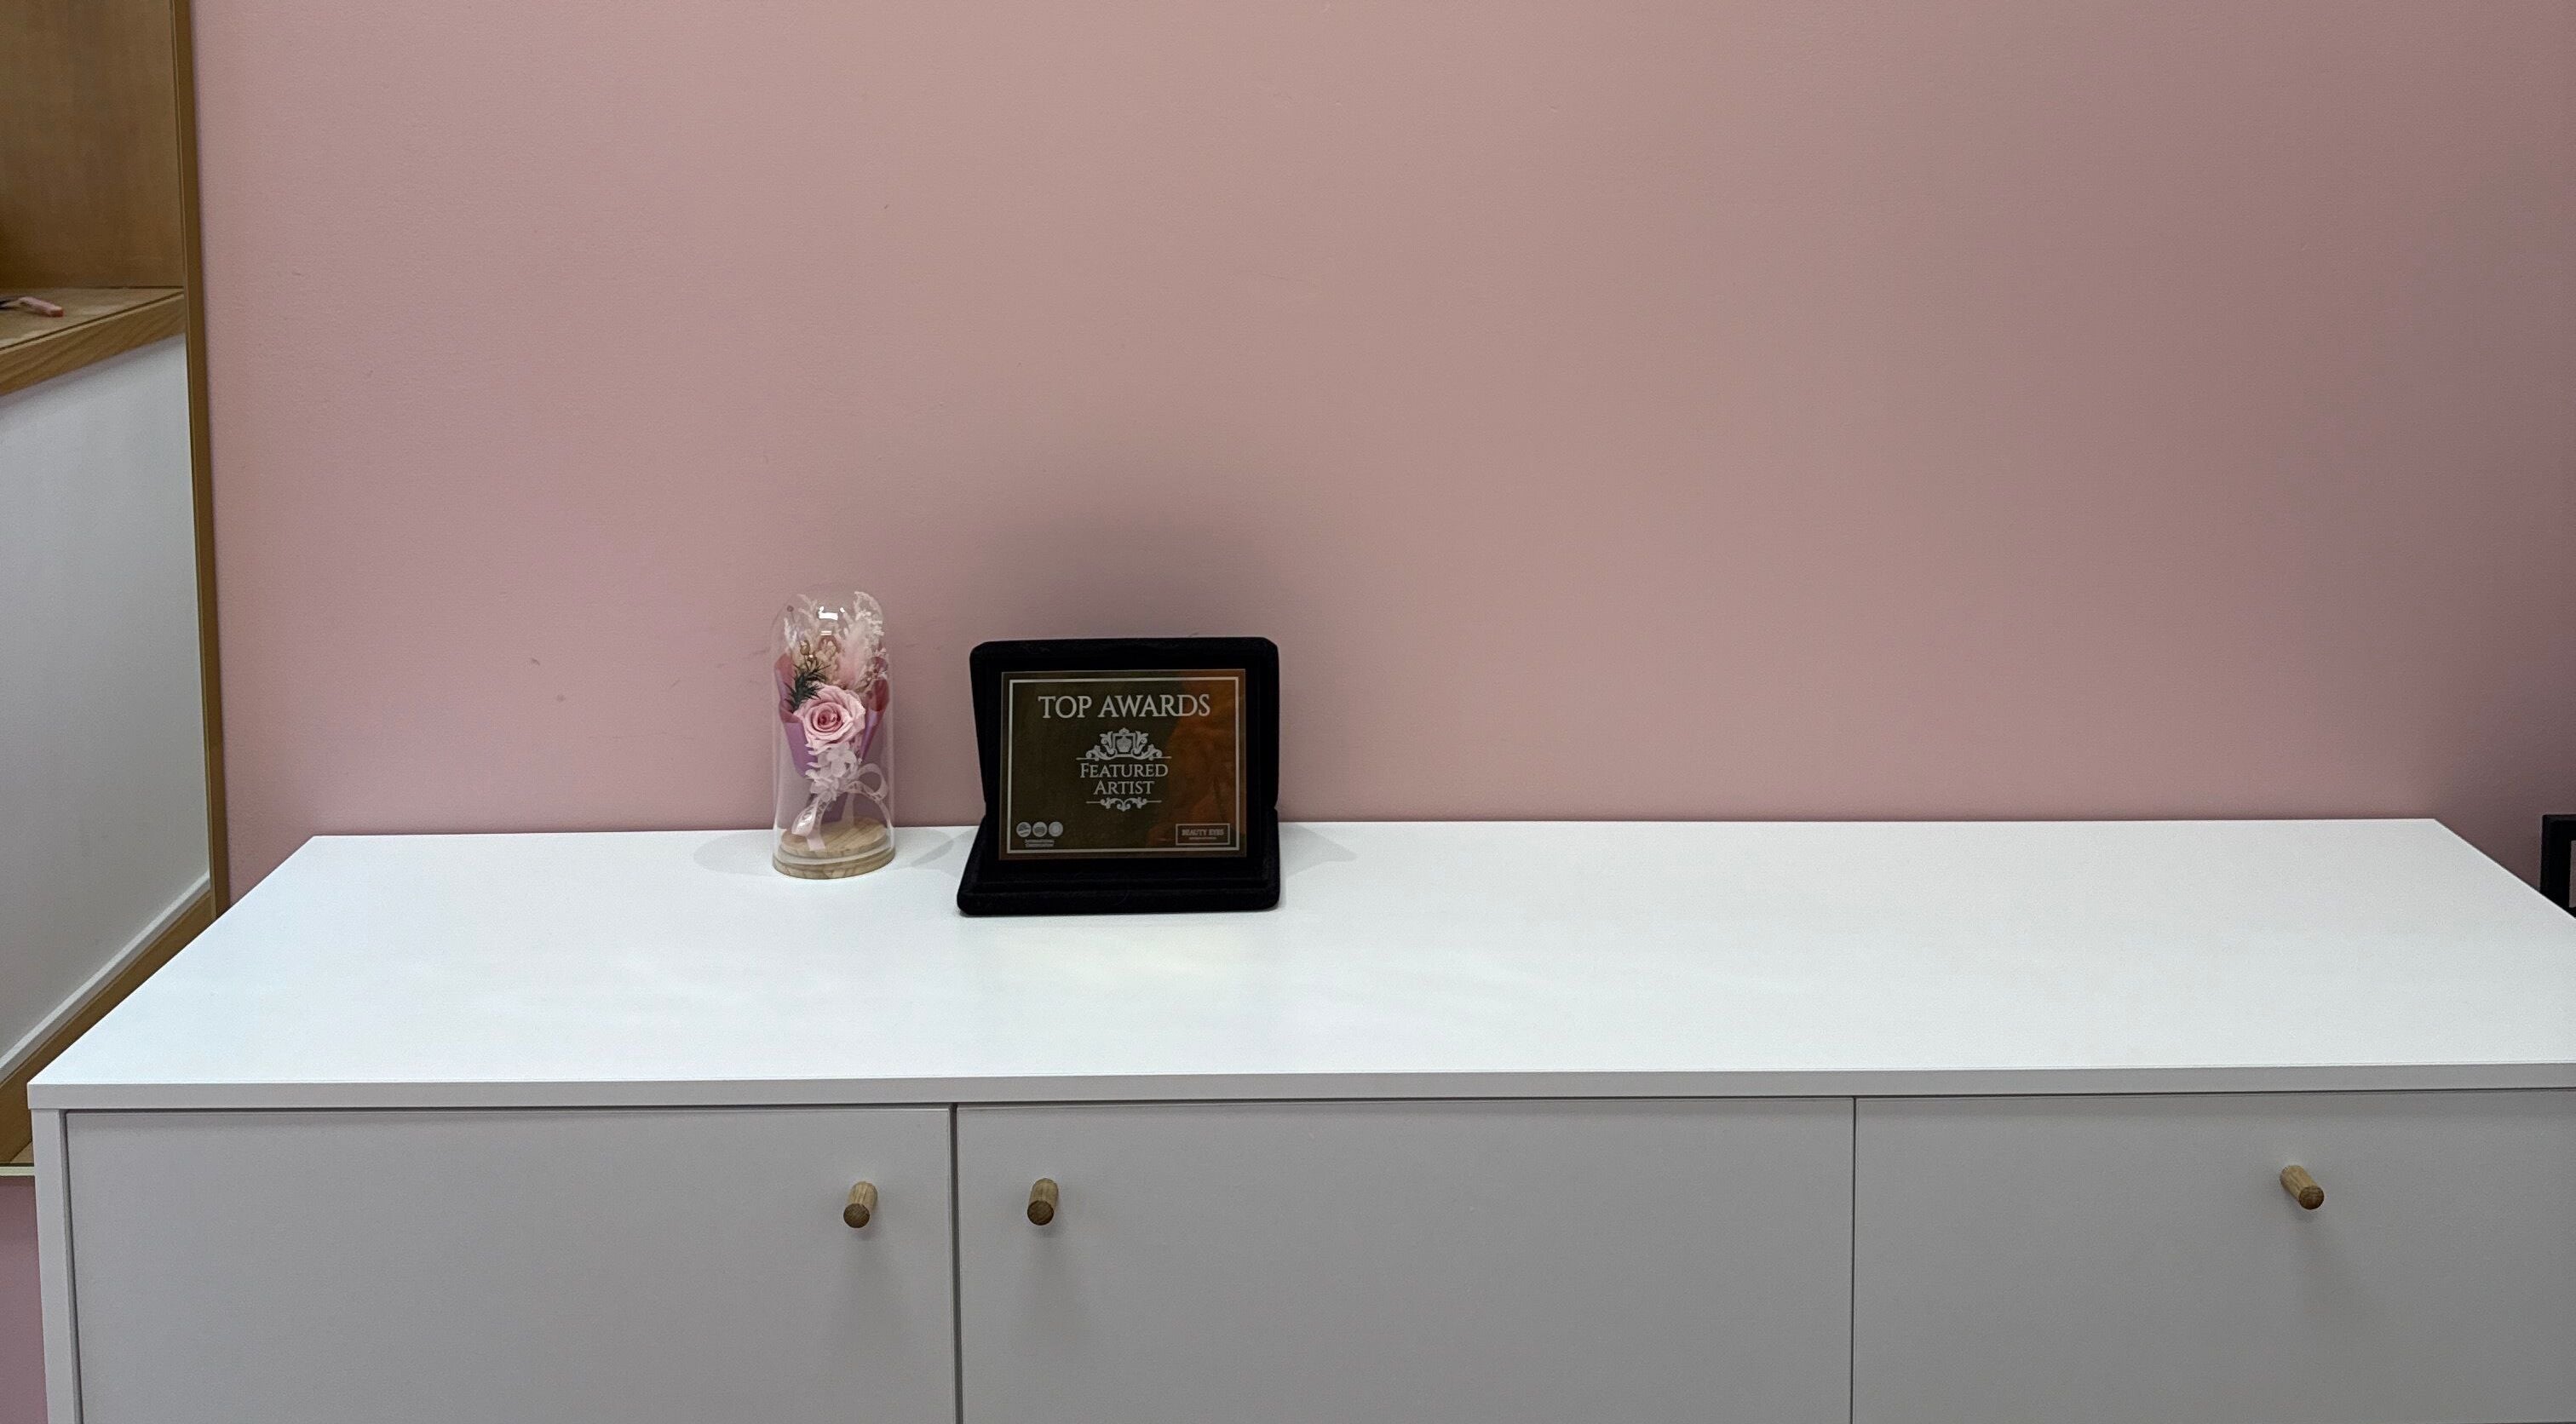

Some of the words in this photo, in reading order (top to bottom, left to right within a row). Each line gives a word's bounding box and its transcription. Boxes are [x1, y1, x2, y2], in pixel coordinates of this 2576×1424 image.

[1038, 695, 1092, 719] TOP
[1097, 693, 1210, 718] AWARDS
[1080, 762, 1169, 778] FEATURED
[1093, 780, 1155, 795] ARTIST
